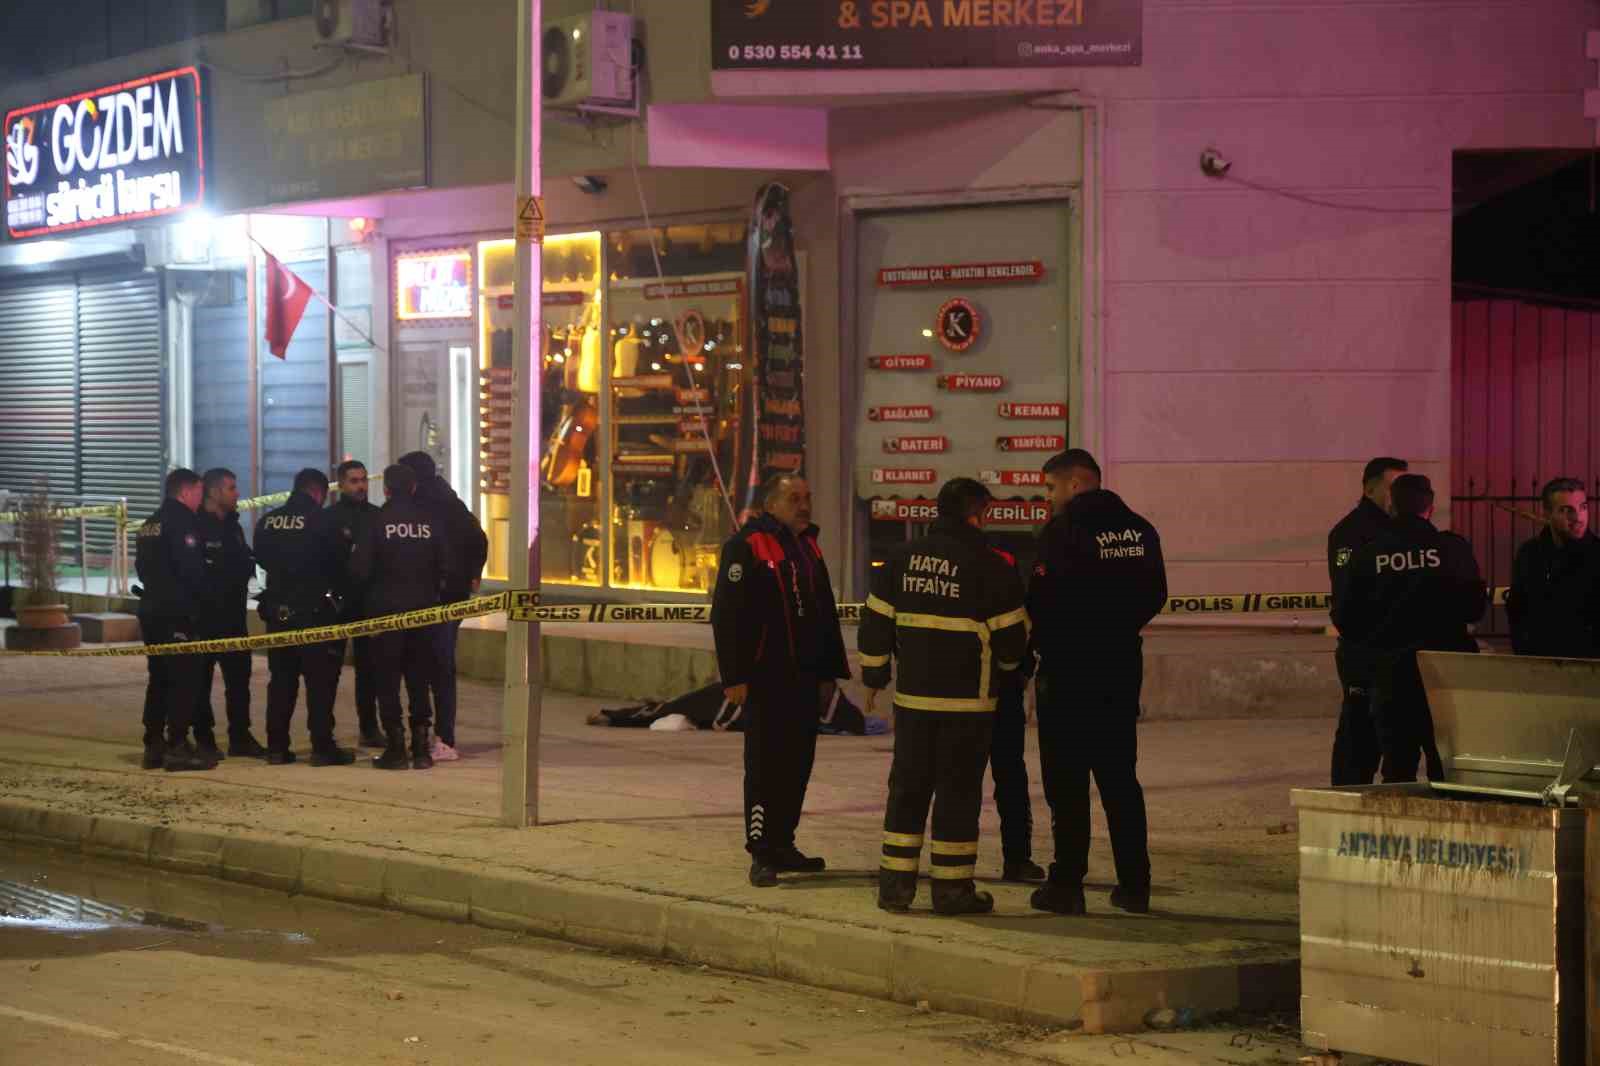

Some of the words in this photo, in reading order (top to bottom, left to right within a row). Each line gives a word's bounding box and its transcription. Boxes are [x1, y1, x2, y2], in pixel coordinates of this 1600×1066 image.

[838, 0, 861, 28] &
[871, 0, 933, 28] SPA
[729, 45, 740, 59] 0
[743, 45, 776, 59] 530
[780, 45, 812, 59] 554
[816, 45, 837, 59] 41
[841, 45, 863, 59] 11
[946, 311, 967, 337] K
[956, 375, 1001, 388] PİYANO
[1014, 405, 1060, 416] KEMAN
[901, 438, 943, 450] BATERİ
[1012, 472, 1040, 484] ŞAN
[898, 506, 938, 518] DERS
[1336, 830, 1412, 862] ANTAKYA
